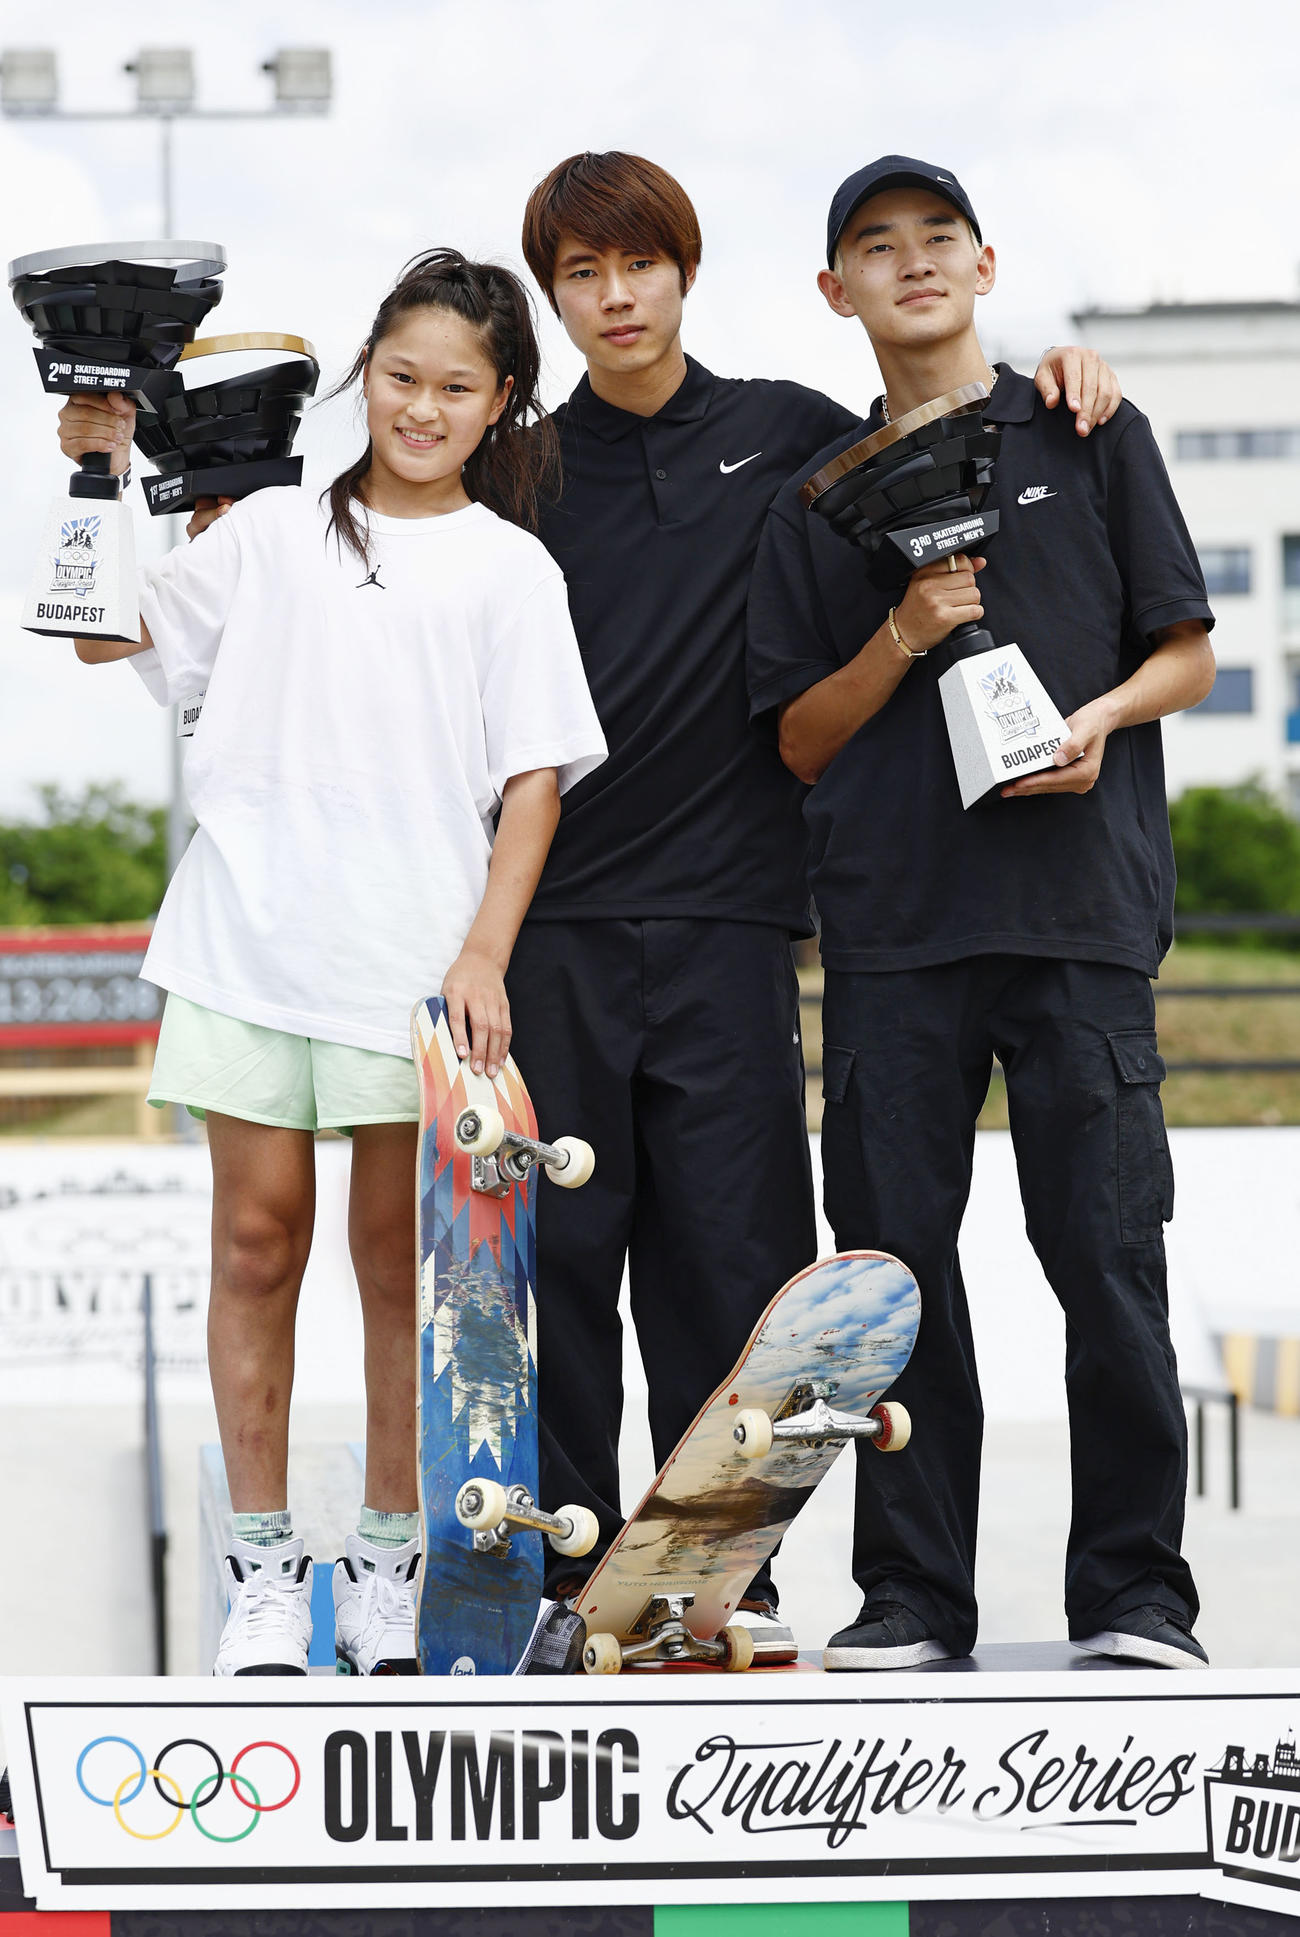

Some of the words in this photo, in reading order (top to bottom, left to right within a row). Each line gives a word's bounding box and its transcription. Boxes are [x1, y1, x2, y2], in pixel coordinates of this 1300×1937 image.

[47, 362, 72, 382] 2ND
[73, 375, 99, 386] STREET
[103, 378, 126, 388] MEN'S
[74, 364, 131, 378] SKATEBOARDING
[1023, 485, 1049, 498] NIKE
[932, 517, 985, 541] SKATEBOARDING
[936, 535, 960, 550] STREET
[962, 527, 985, 542] MEN'S
[909, 534, 932, 557] 3RD
[56, 565, 93, 580] OLYMPIC
[36, 602, 105, 623] BUDAPEST
[999, 708, 1034, 730] OLYMPIC
[324, 1728, 640, 1843] OLYMPIC
[666, 1734, 965, 1849] Qualifier
[972, 1729, 1197, 1831] Series
